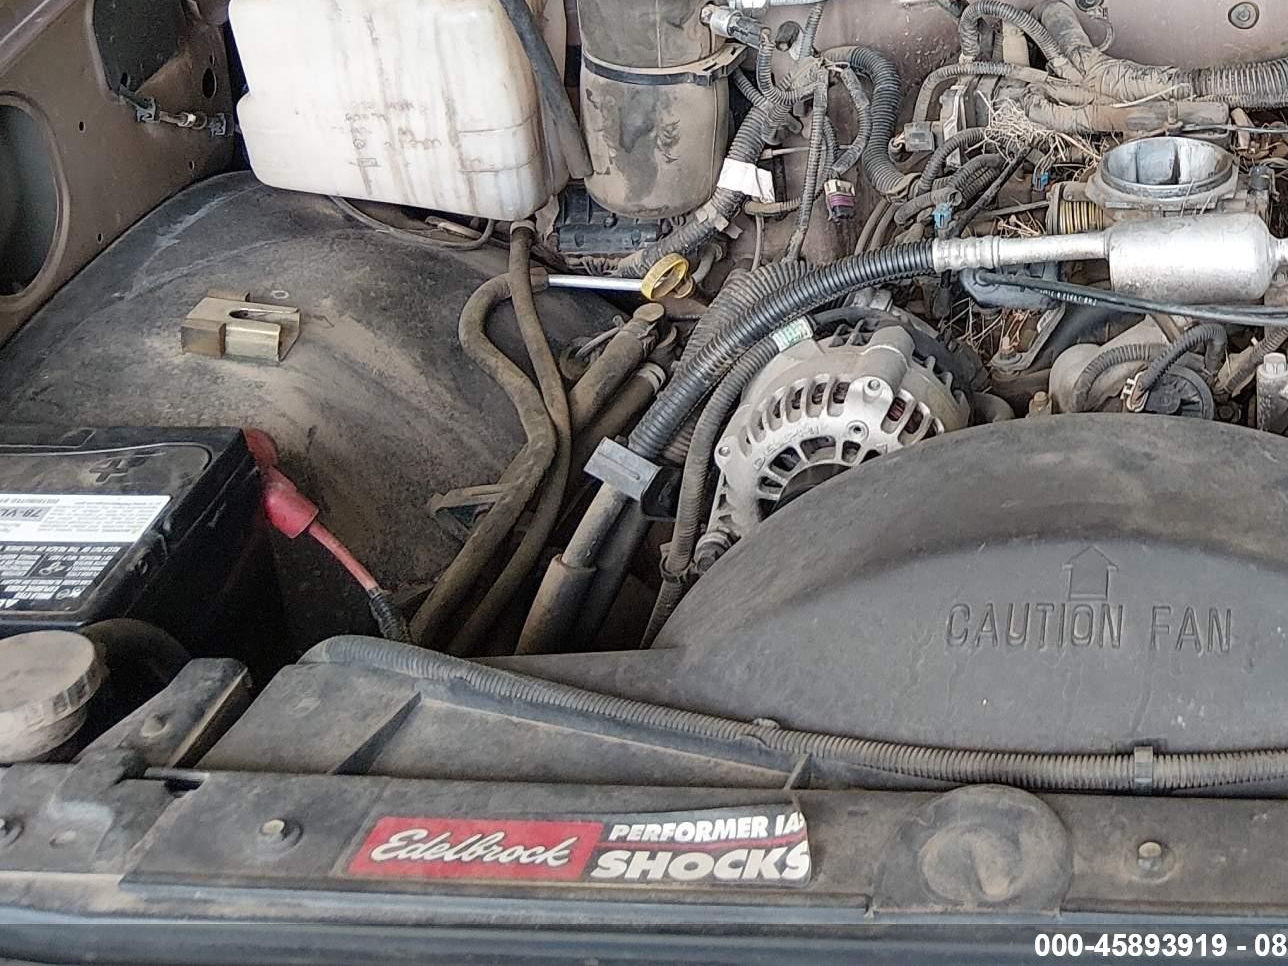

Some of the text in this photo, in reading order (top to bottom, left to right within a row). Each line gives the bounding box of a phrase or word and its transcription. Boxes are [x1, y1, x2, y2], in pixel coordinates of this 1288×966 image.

[945, 602, 1232, 652] CAUTION FAN
[371, 829, 579, 868] Edelbrock
[607, 816, 766, 843] PERFORMER
[591, 841, 811, 881] SHOCKS
